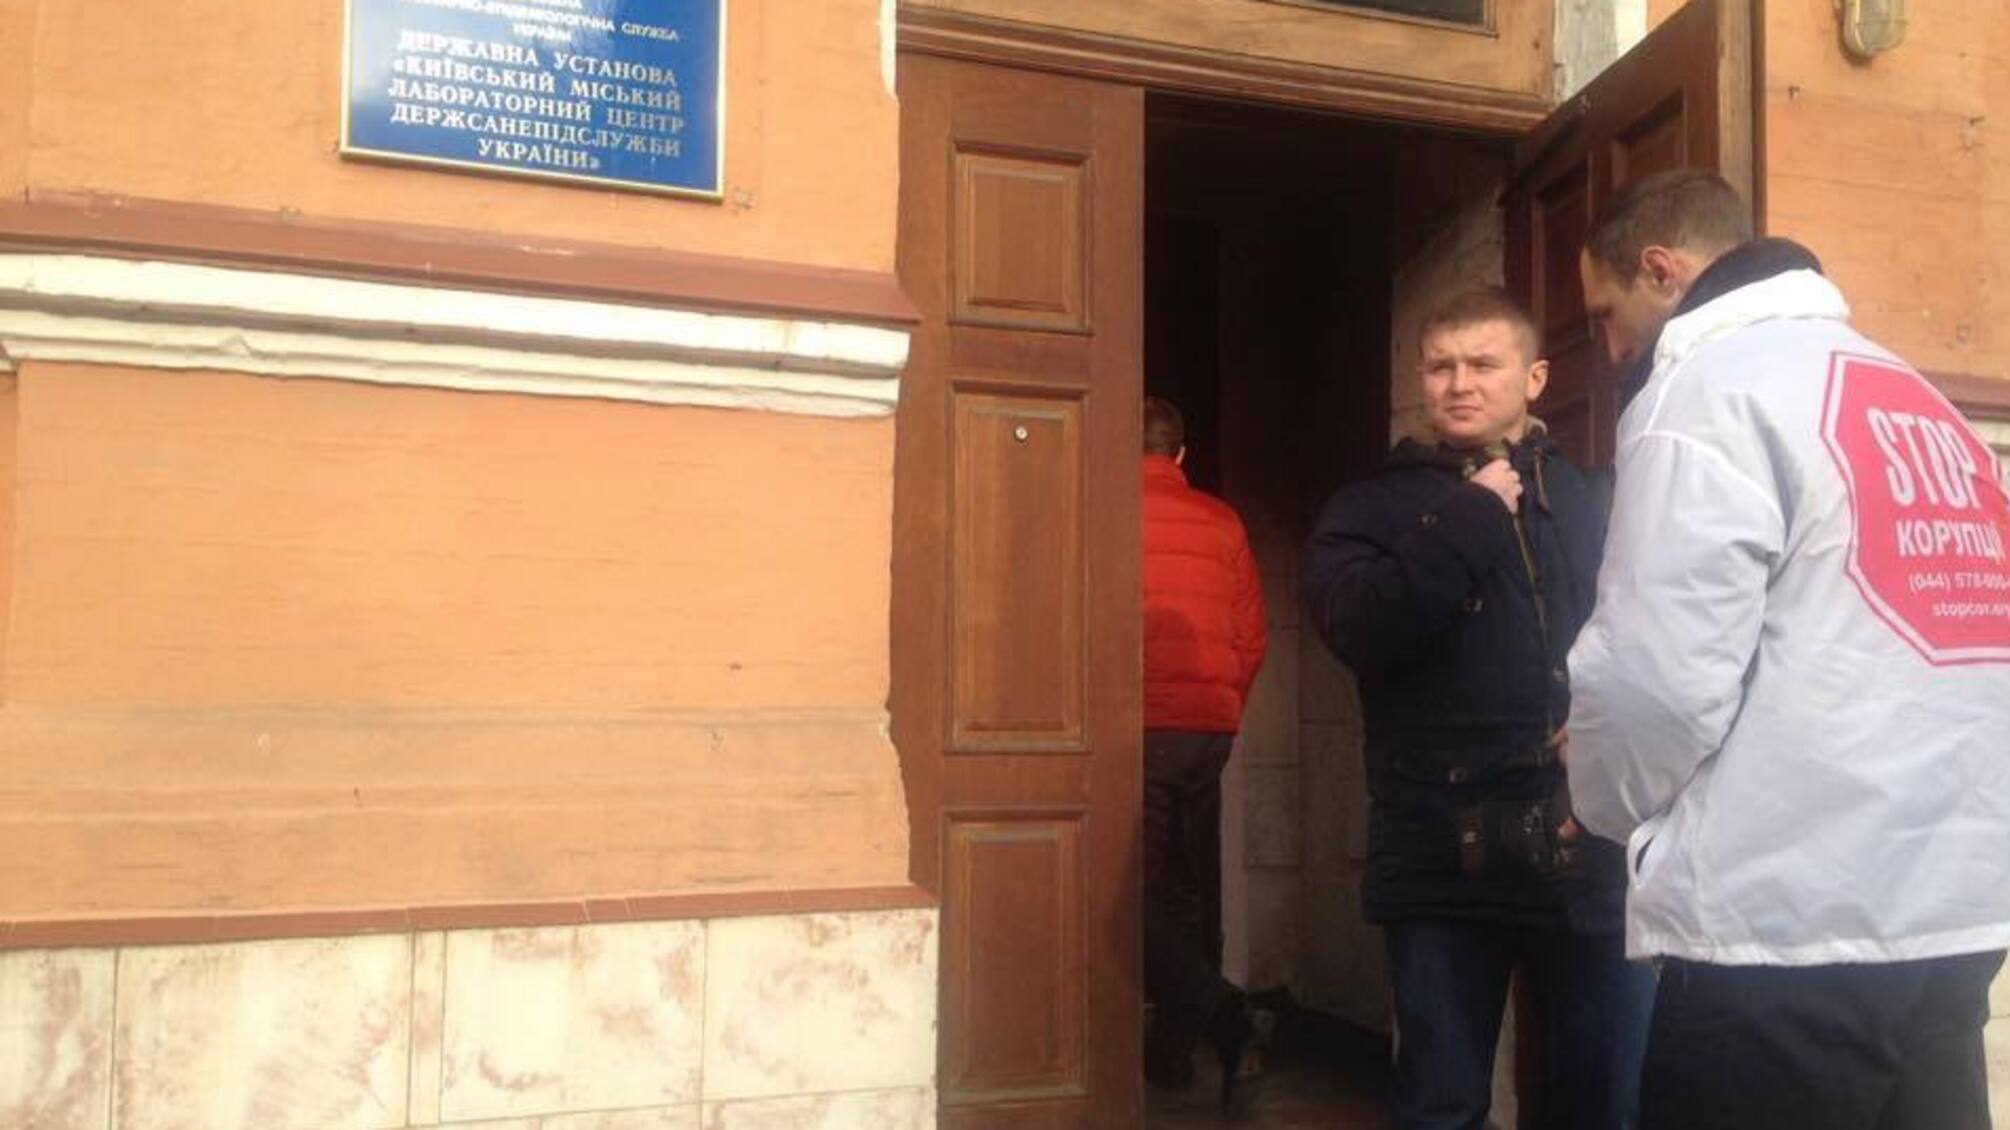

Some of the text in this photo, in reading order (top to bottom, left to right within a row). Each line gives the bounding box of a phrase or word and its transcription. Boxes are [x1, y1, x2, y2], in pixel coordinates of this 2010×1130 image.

[393, 56, 682, 111] «КИЇВСЬКИЙ МІСЬКИЙ
[397, 29, 678, 87] ДЕРЖАВНА УСТАНОВА
[388, 78, 685, 134] ЛАБОРАТОРНИЙ ЦЕНТР
[390, 103, 681, 158] ДЕРЖСАНЕПІДСЛУЖБИ
[478, 138, 600, 169] УКРАЇНИ»
[1866, 406, 1983, 509] STOP
